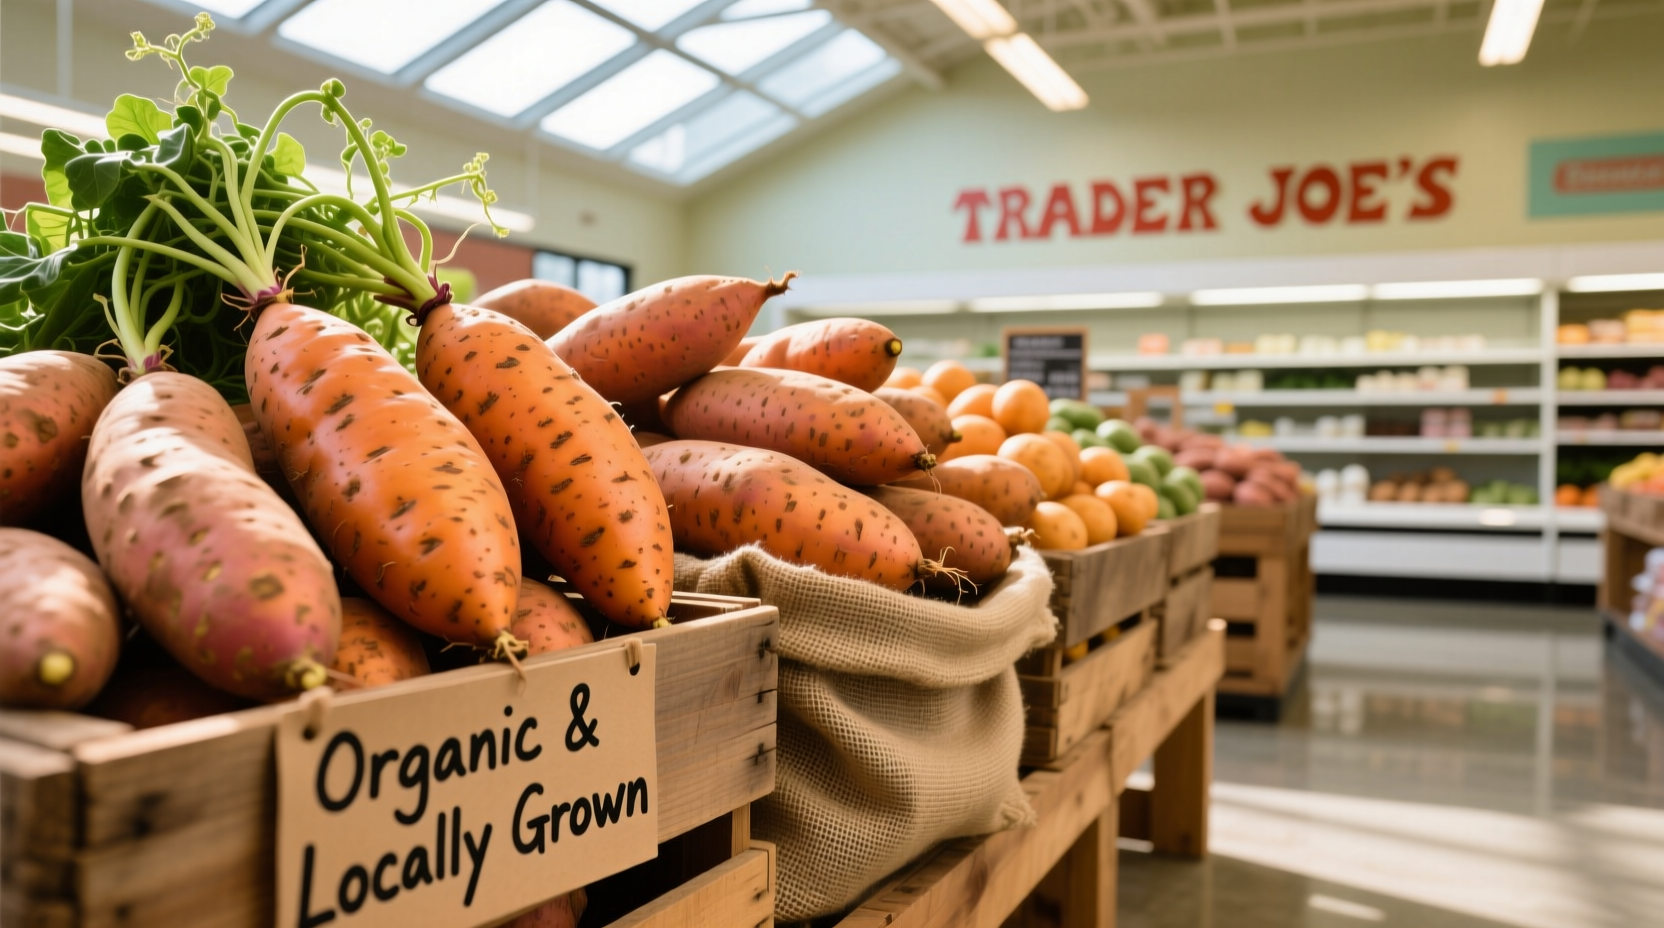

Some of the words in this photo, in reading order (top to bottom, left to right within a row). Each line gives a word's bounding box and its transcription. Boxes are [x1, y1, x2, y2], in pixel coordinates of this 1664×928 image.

[954, 172, 1219, 243] TRADER
[1248, 156, 1459, 227] JOE'S
[316, 705, 542, 825] Organic
[565, 683, 599, 752] &
[298, 806, 492, 928] Locally
[512, 777, 648, 854] Grown
